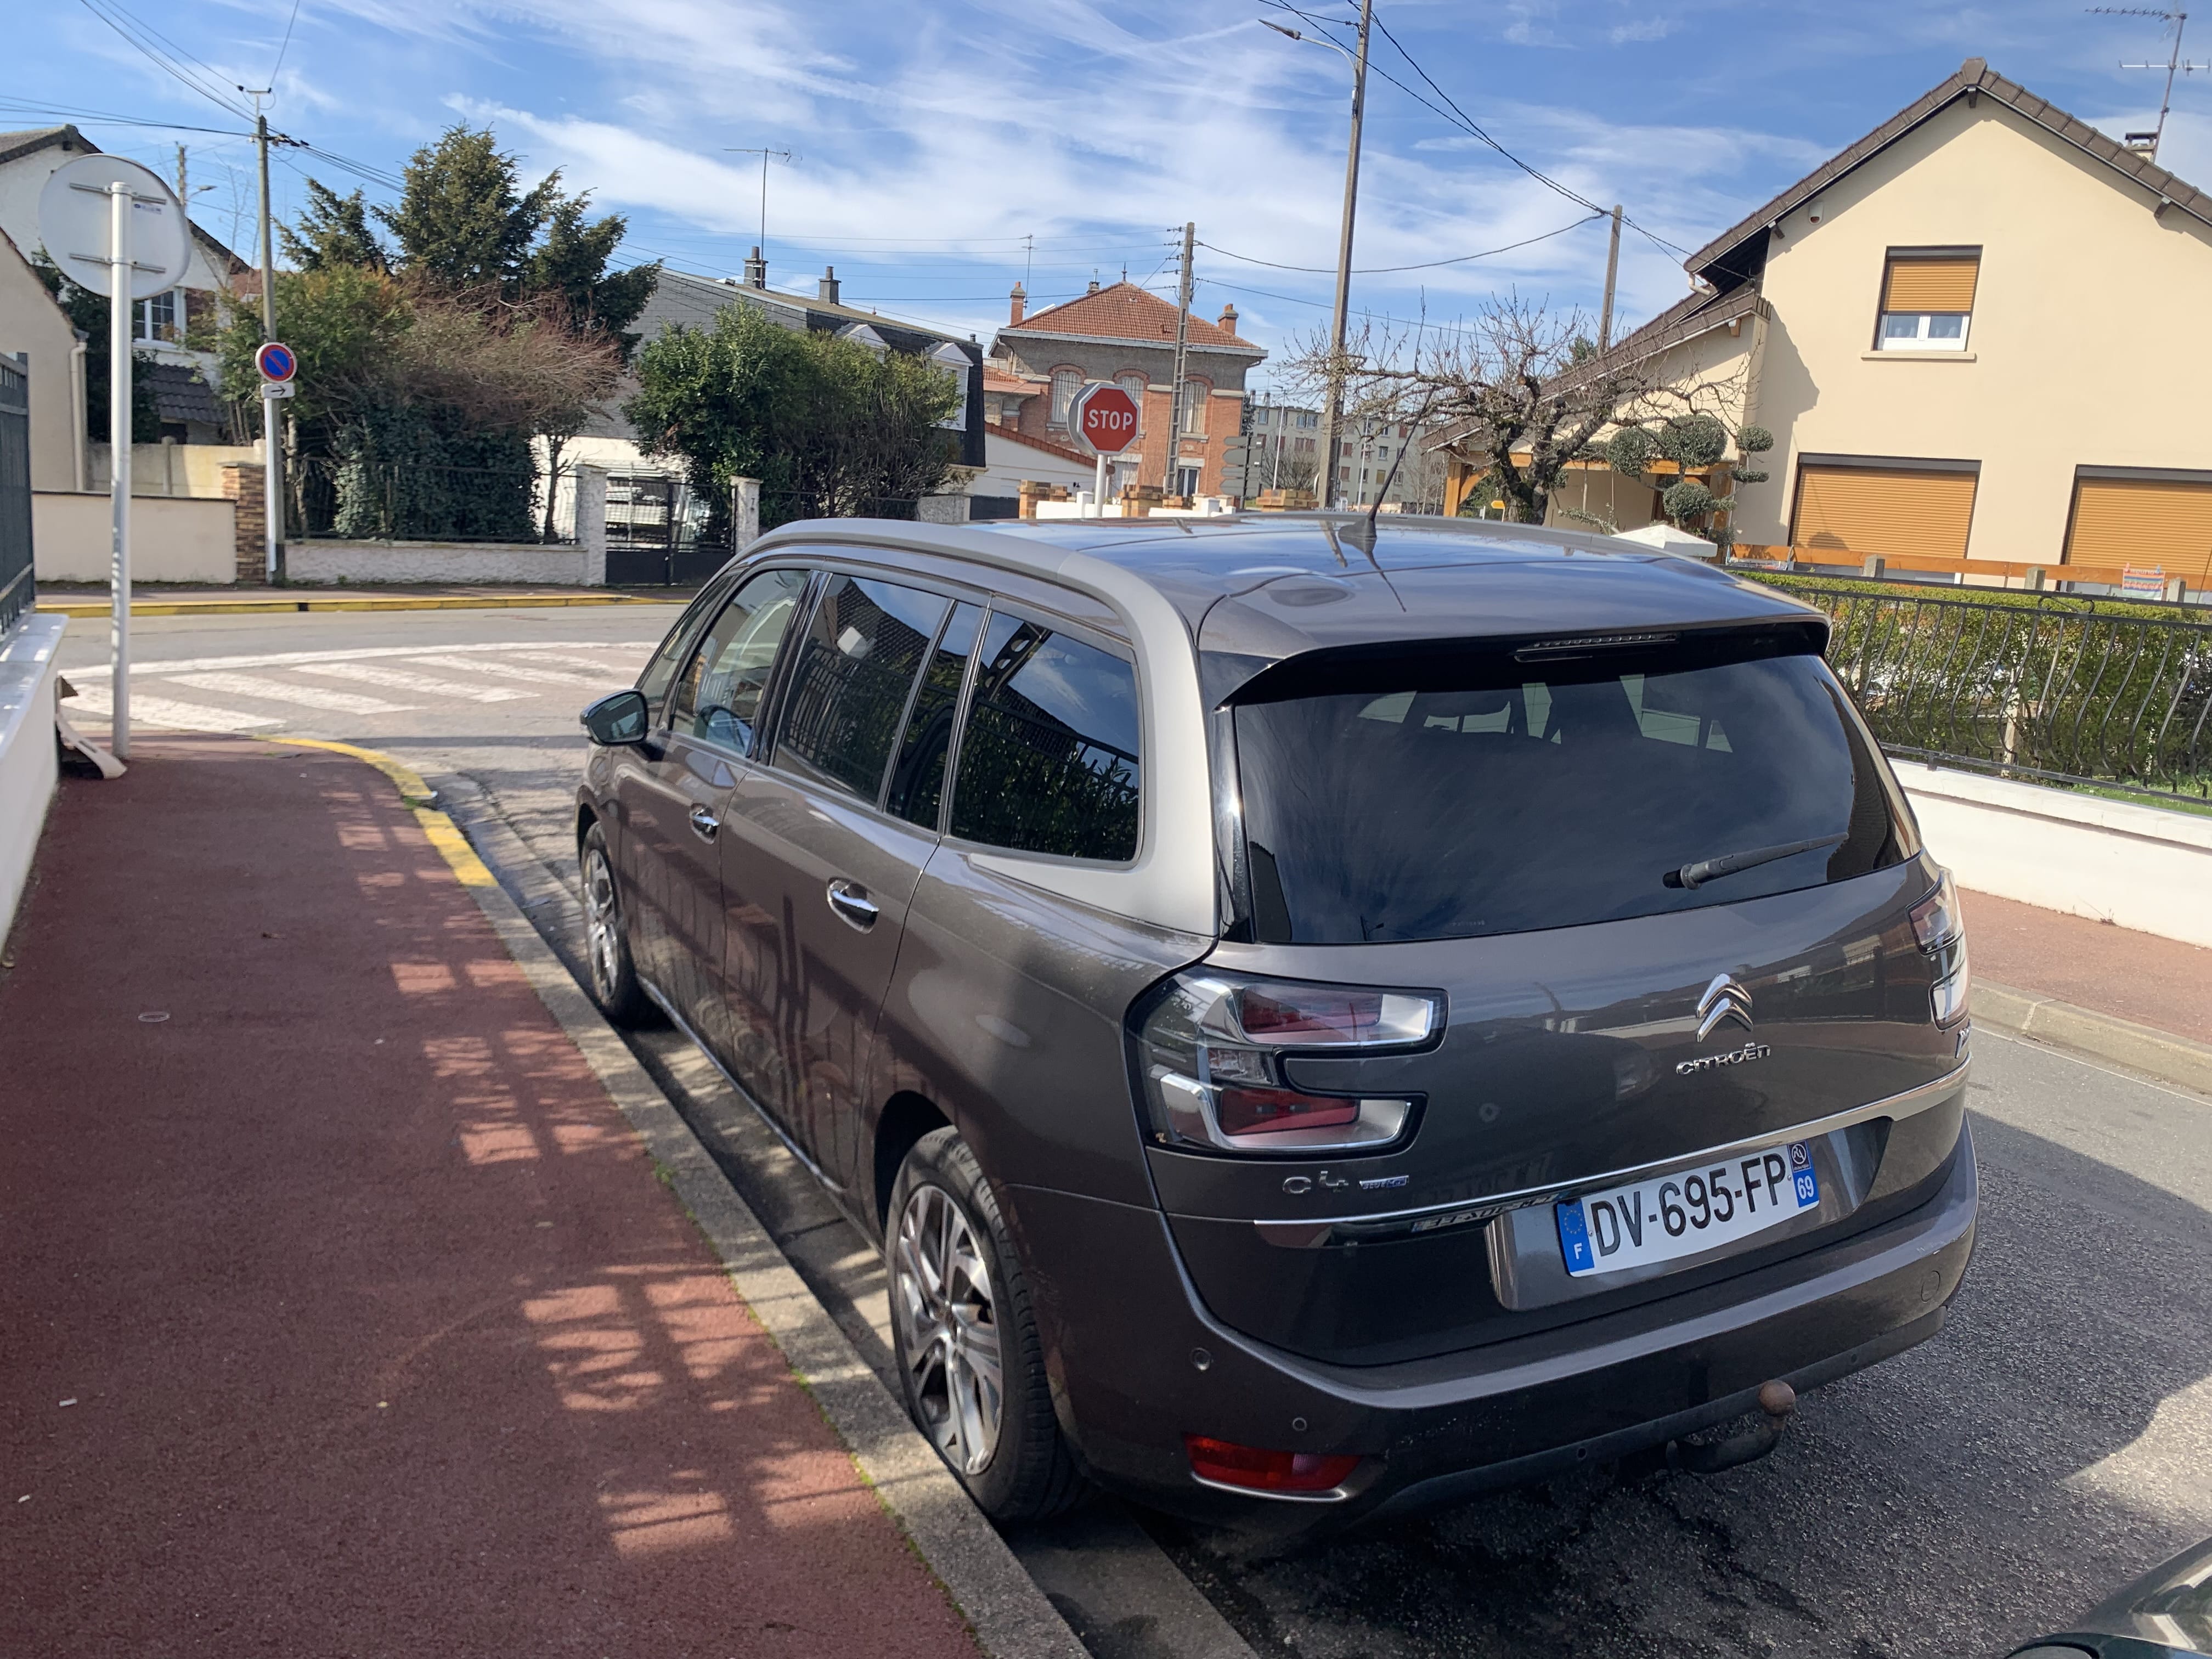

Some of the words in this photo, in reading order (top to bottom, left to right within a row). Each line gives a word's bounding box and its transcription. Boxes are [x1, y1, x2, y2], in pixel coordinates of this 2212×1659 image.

[1087, 409, 1133, 431] STOP
[1676, 1042, 1771, 1075] CITROËN
[1282, 1170, 1349, 1194] C4
[1797, 1175, 1815, 1200] 69
[1591, 1153, 1786, 1257] DV-695-FP
[1573, 1243, 1582, 1260] F
